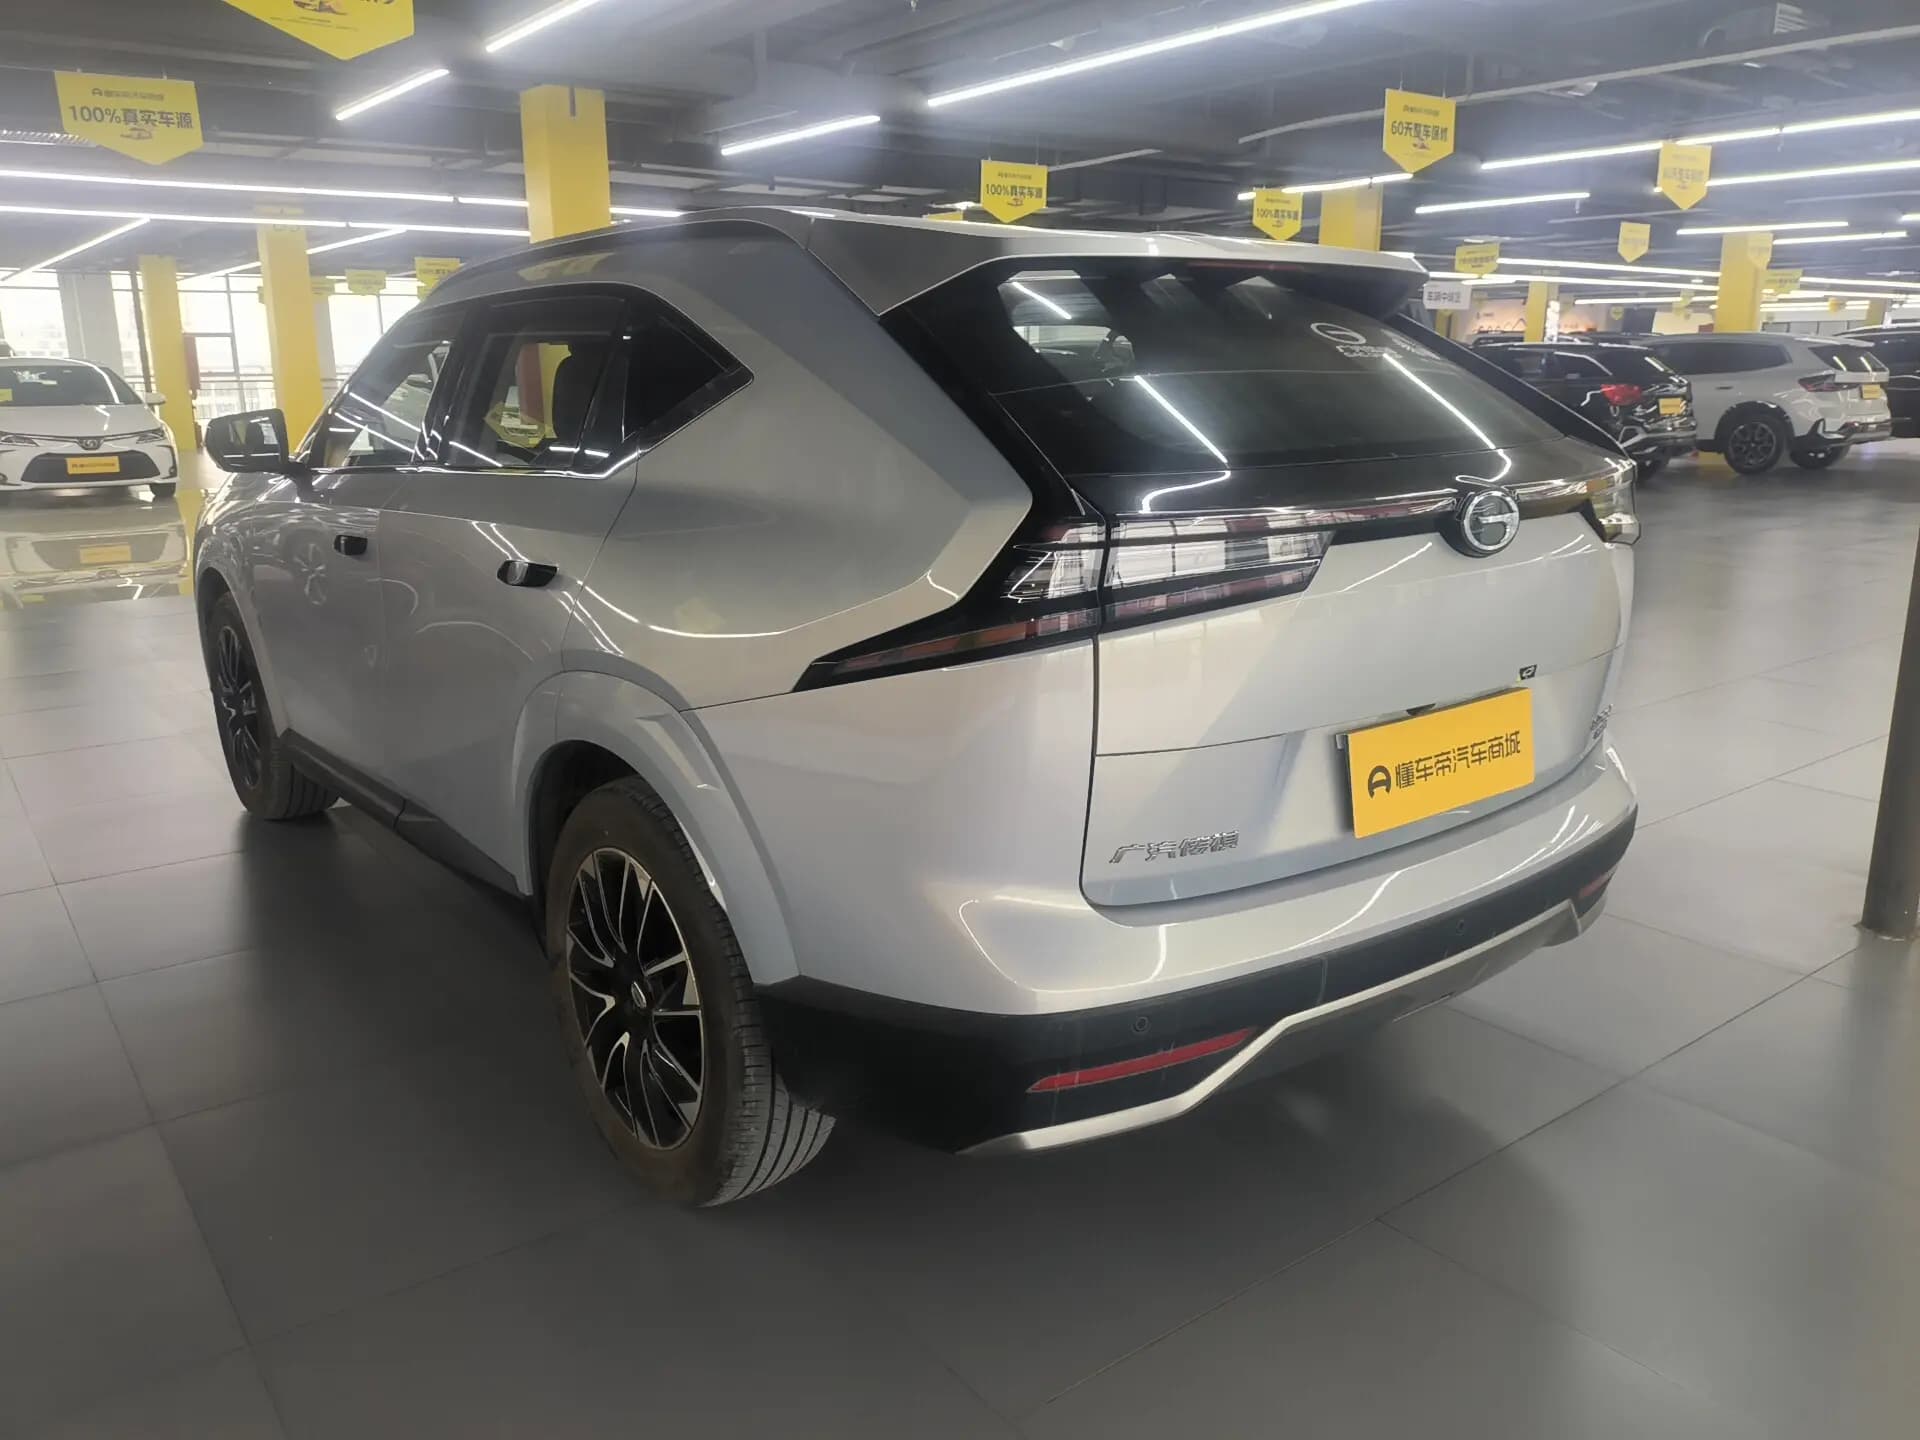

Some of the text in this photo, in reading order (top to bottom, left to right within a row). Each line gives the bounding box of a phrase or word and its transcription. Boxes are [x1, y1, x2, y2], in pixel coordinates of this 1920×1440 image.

[68, 105, 193, 128] 100%真实车源
[1395, 730, 1521, 790] 懂车帝汽车商城
